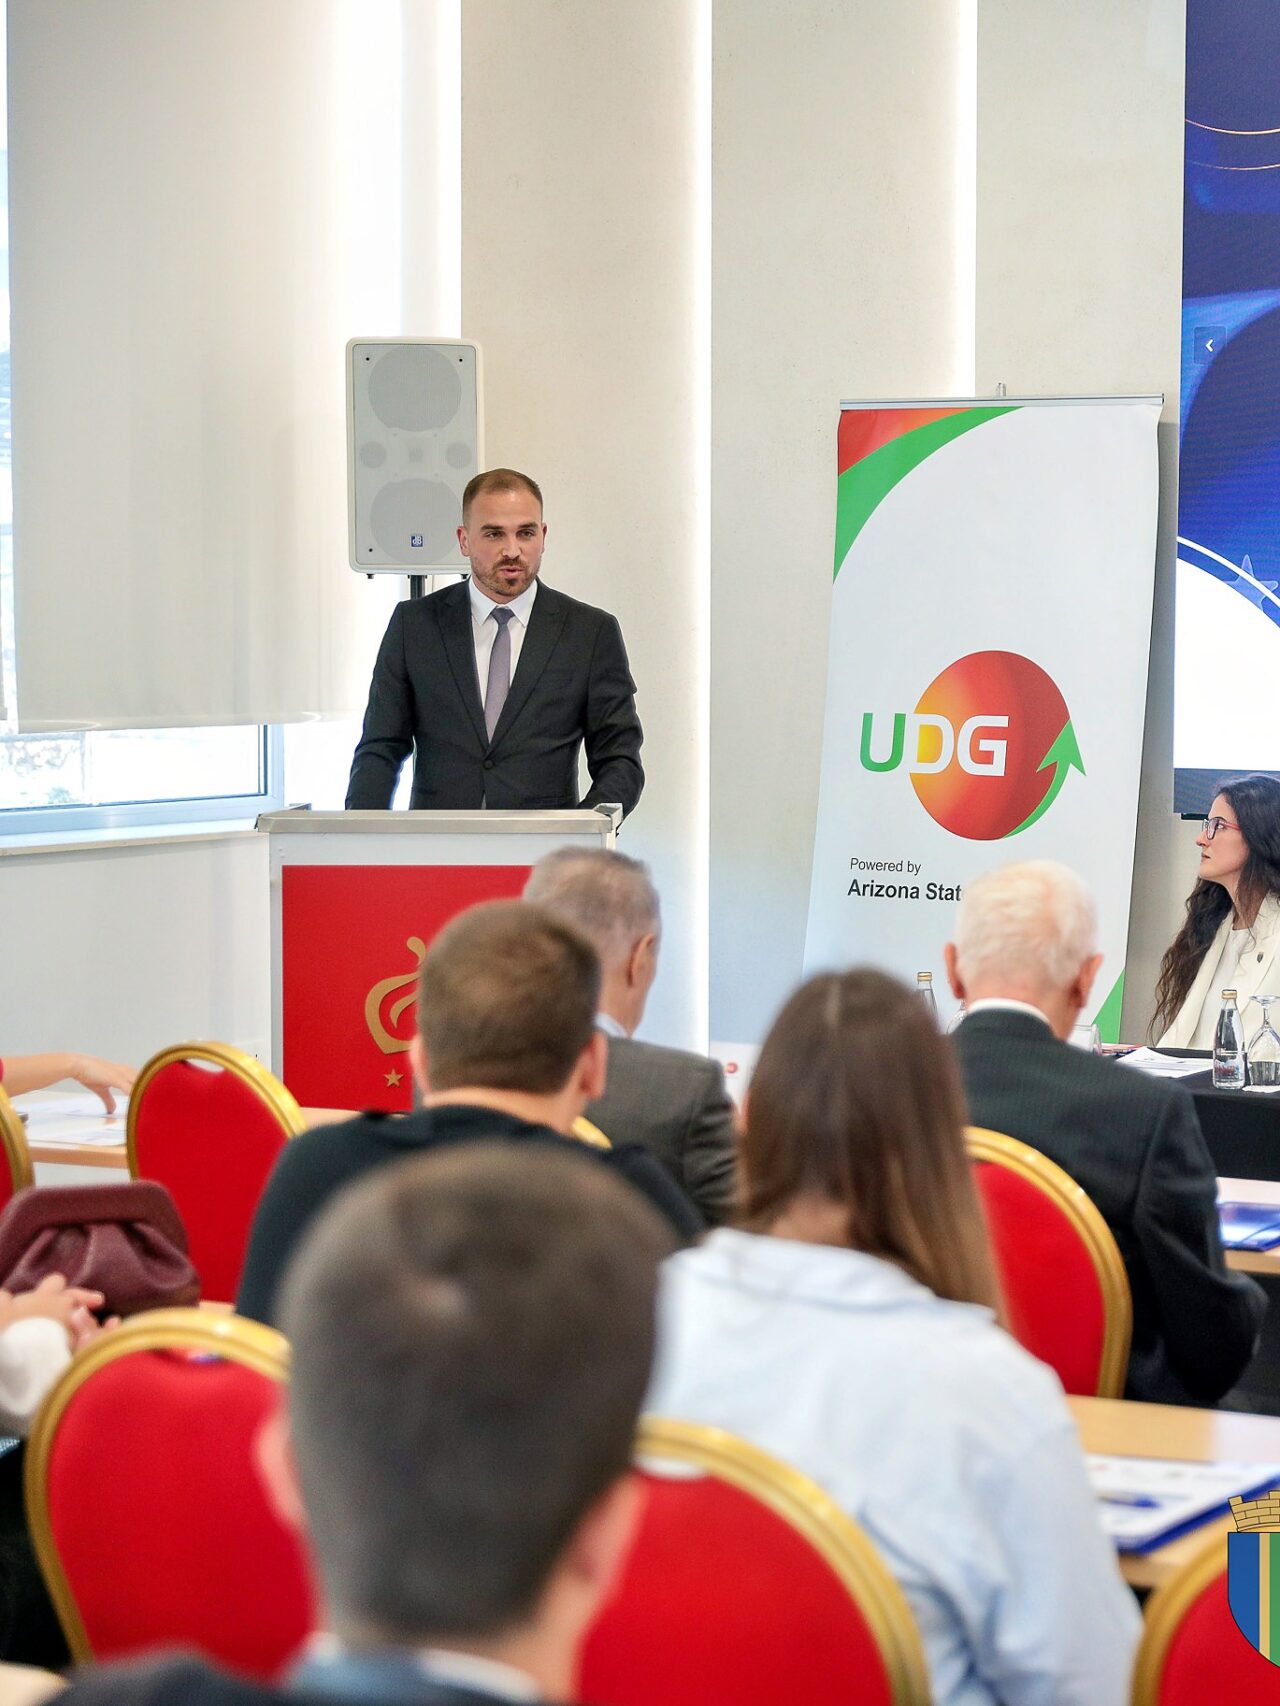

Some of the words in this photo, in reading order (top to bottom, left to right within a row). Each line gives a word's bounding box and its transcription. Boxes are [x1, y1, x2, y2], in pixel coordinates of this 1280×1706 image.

[859, 712, 1009, 776] UDG
[850, 857, 904, 872] Powered
[907, 861, 921, 876] by
[847, 878, 920, 900] Arizona
[925, 882, 962, 901] Stat
